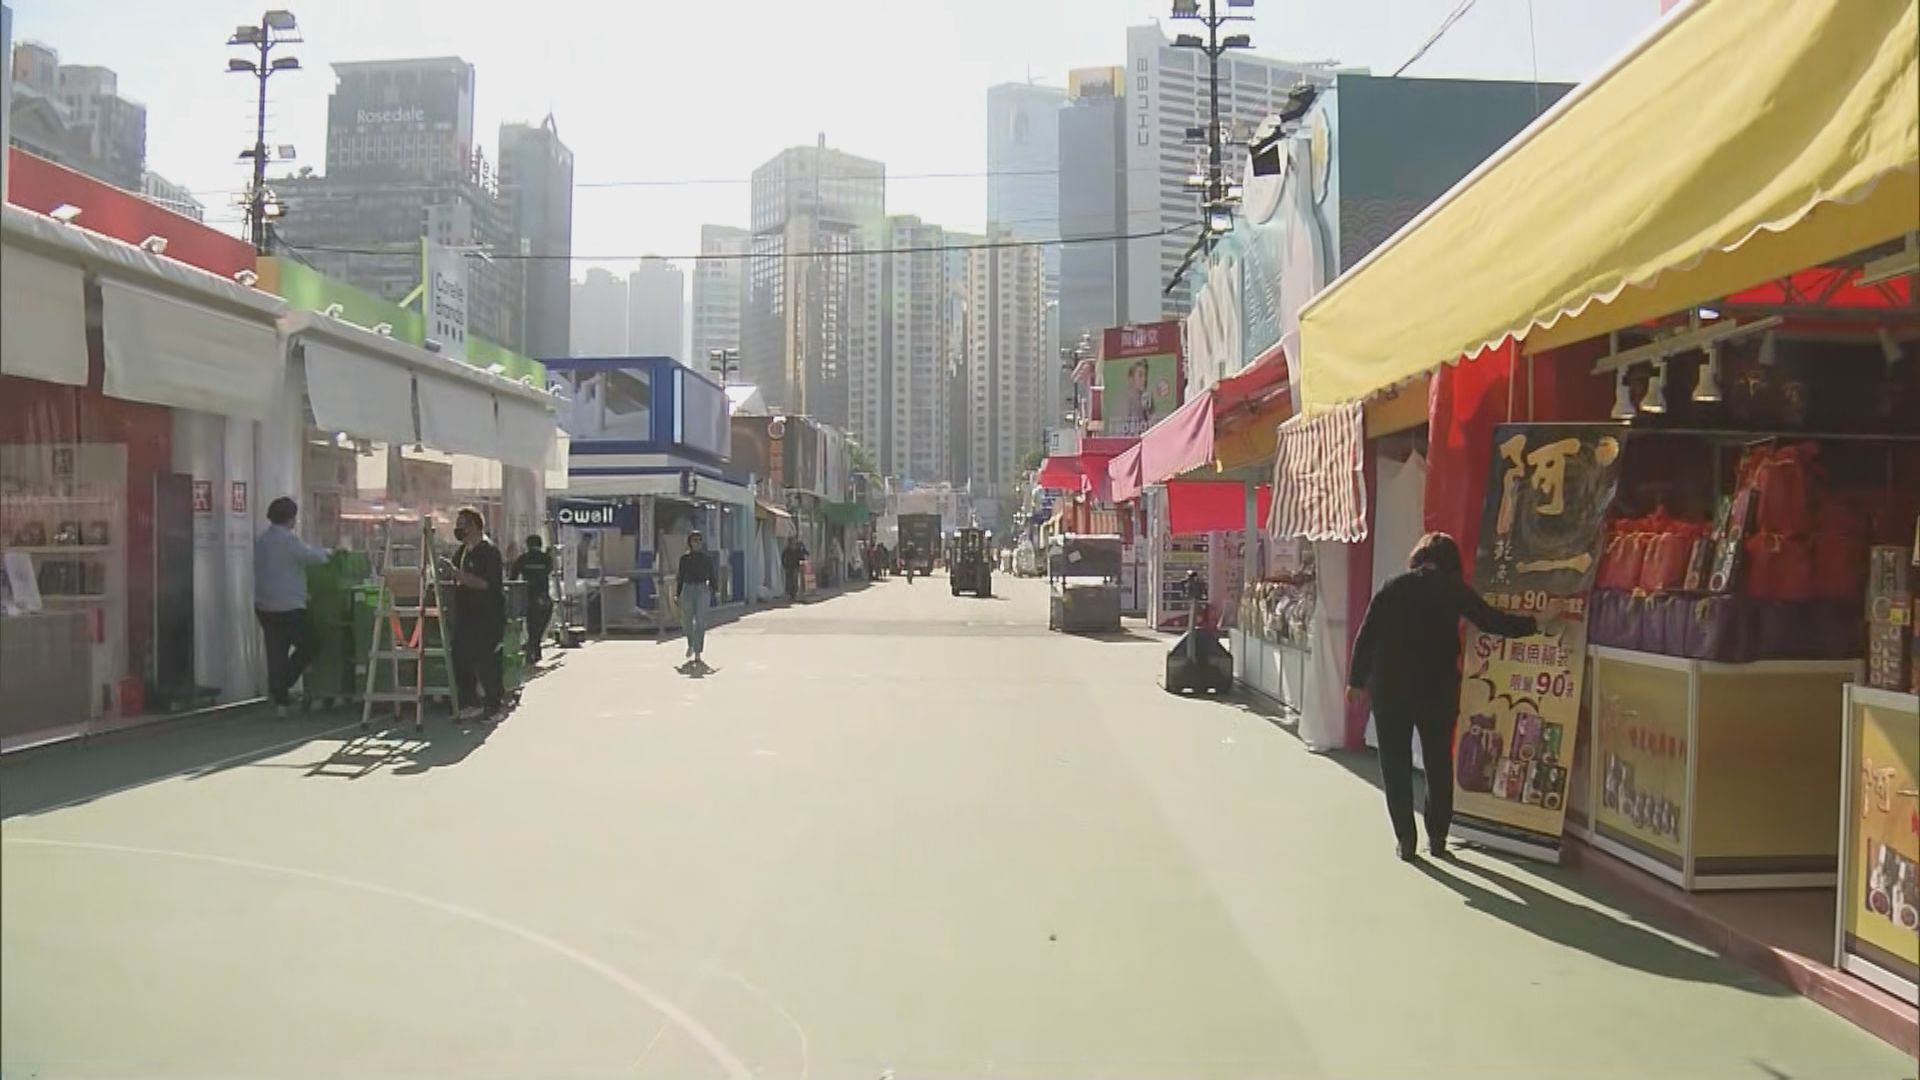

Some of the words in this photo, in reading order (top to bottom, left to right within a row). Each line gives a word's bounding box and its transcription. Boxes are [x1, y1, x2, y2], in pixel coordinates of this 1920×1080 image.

[357, 104, 425, 123] Rosedale
[1137, 57, 1149, 145] CHUBB
[435, 295, 465, 326] Brands
[1496, 434, 1593, 574] 阿一
